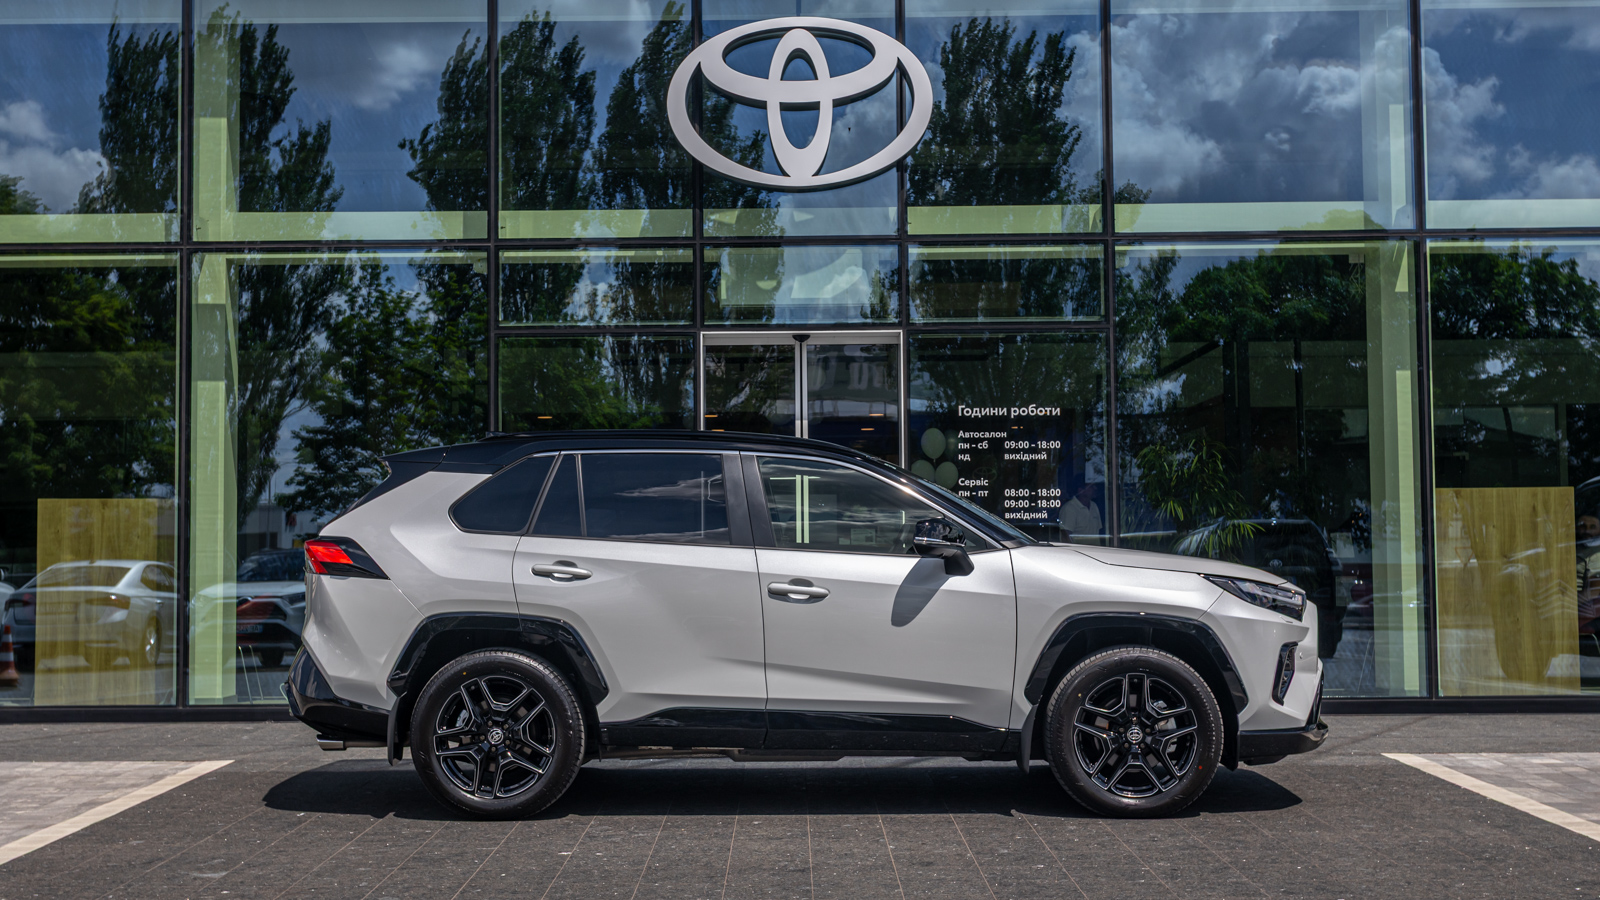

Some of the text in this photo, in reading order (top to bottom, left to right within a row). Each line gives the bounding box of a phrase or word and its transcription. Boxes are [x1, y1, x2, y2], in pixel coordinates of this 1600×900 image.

[958, 404, 1061, 419] Години роботи
[957, 431, 1007, 439] Автосалон
[977, 441, 989, 450] сб
[1004, 441, 1030, 449] 09:00
[1037, 441, 1061, 449] 18:00
[958, 452, 1048, 462] нд вихідний
[958, 478, 989, 488] Сервіс
[1004, 489, 1030, 497] 08:00
[1037, 489, 1062, 497] 18:00
[1004, 500, 1030, 508] 09:00
[1037, 500, 1061, 508] 18:00
[1004, 511, 1048, 521] вихідний
